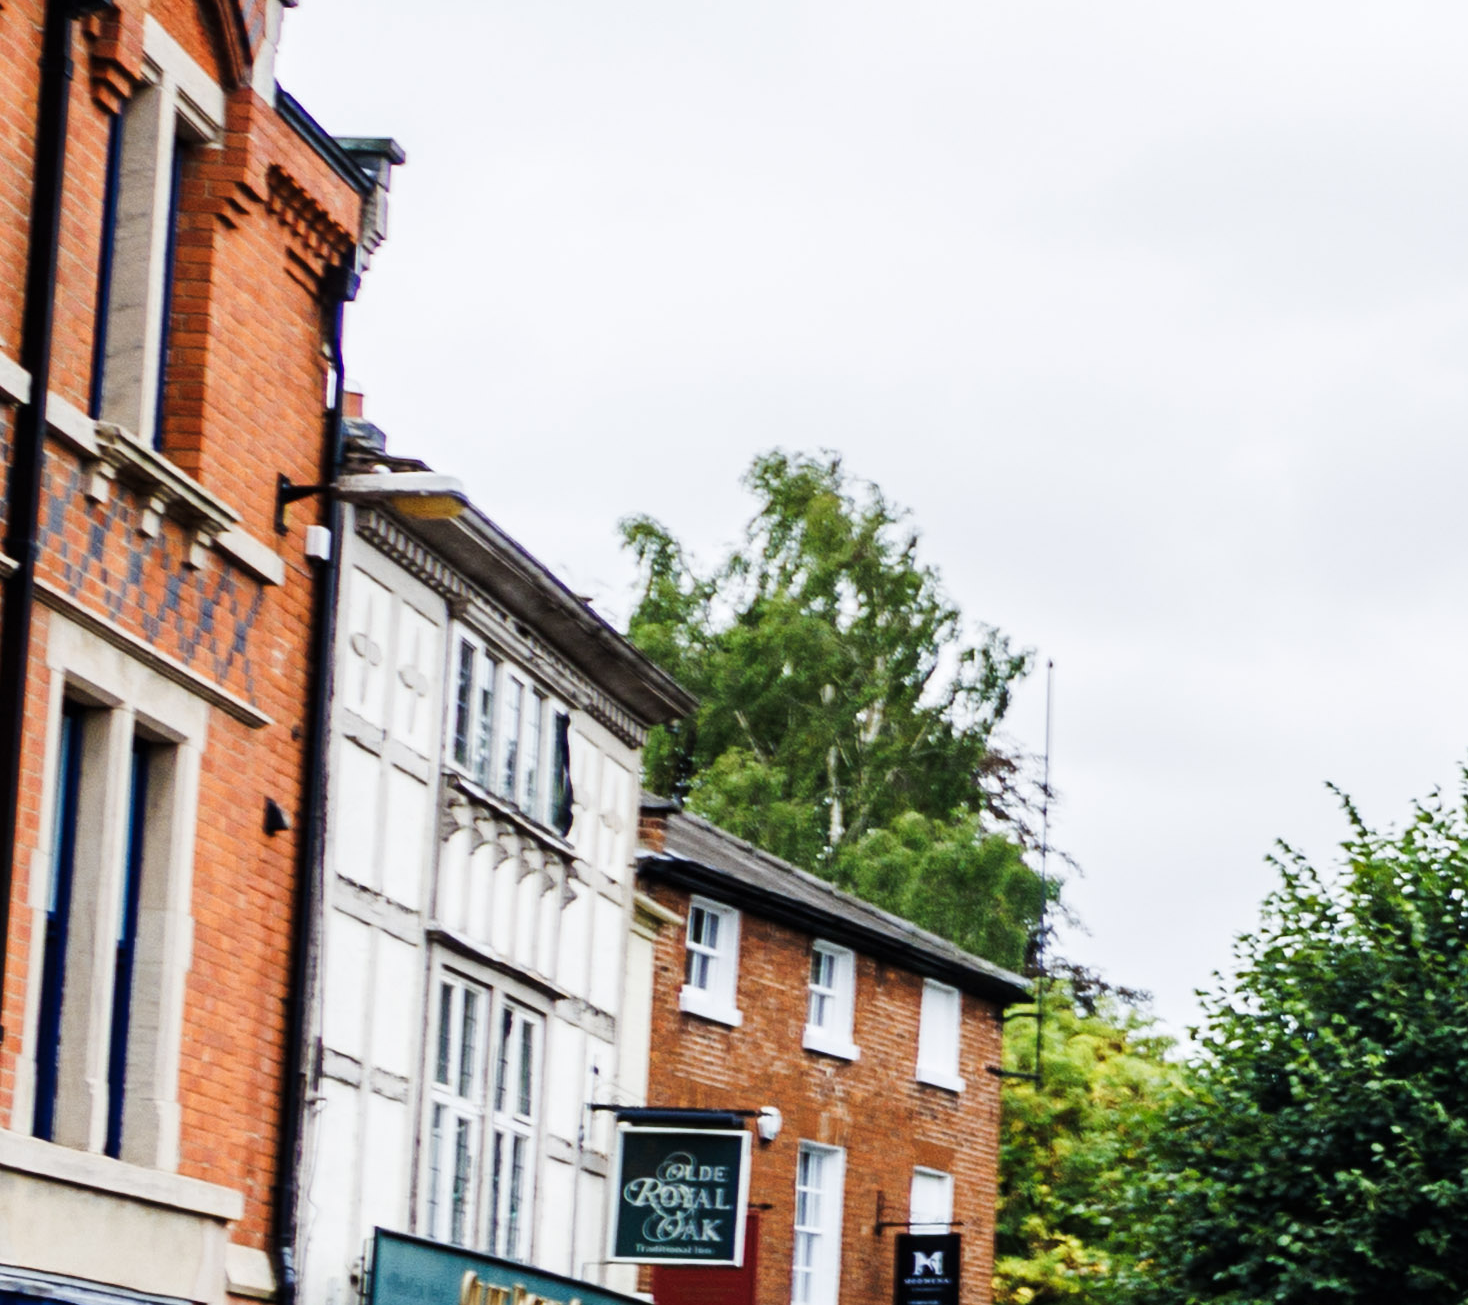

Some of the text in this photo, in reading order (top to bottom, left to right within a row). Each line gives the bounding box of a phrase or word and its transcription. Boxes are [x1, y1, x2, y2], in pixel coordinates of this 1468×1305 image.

[656, 1152, 729, 1182] OLDE
[624, 1177, 734, 1215] ROYAL
[642, 1211, 723, 1242] OAK
